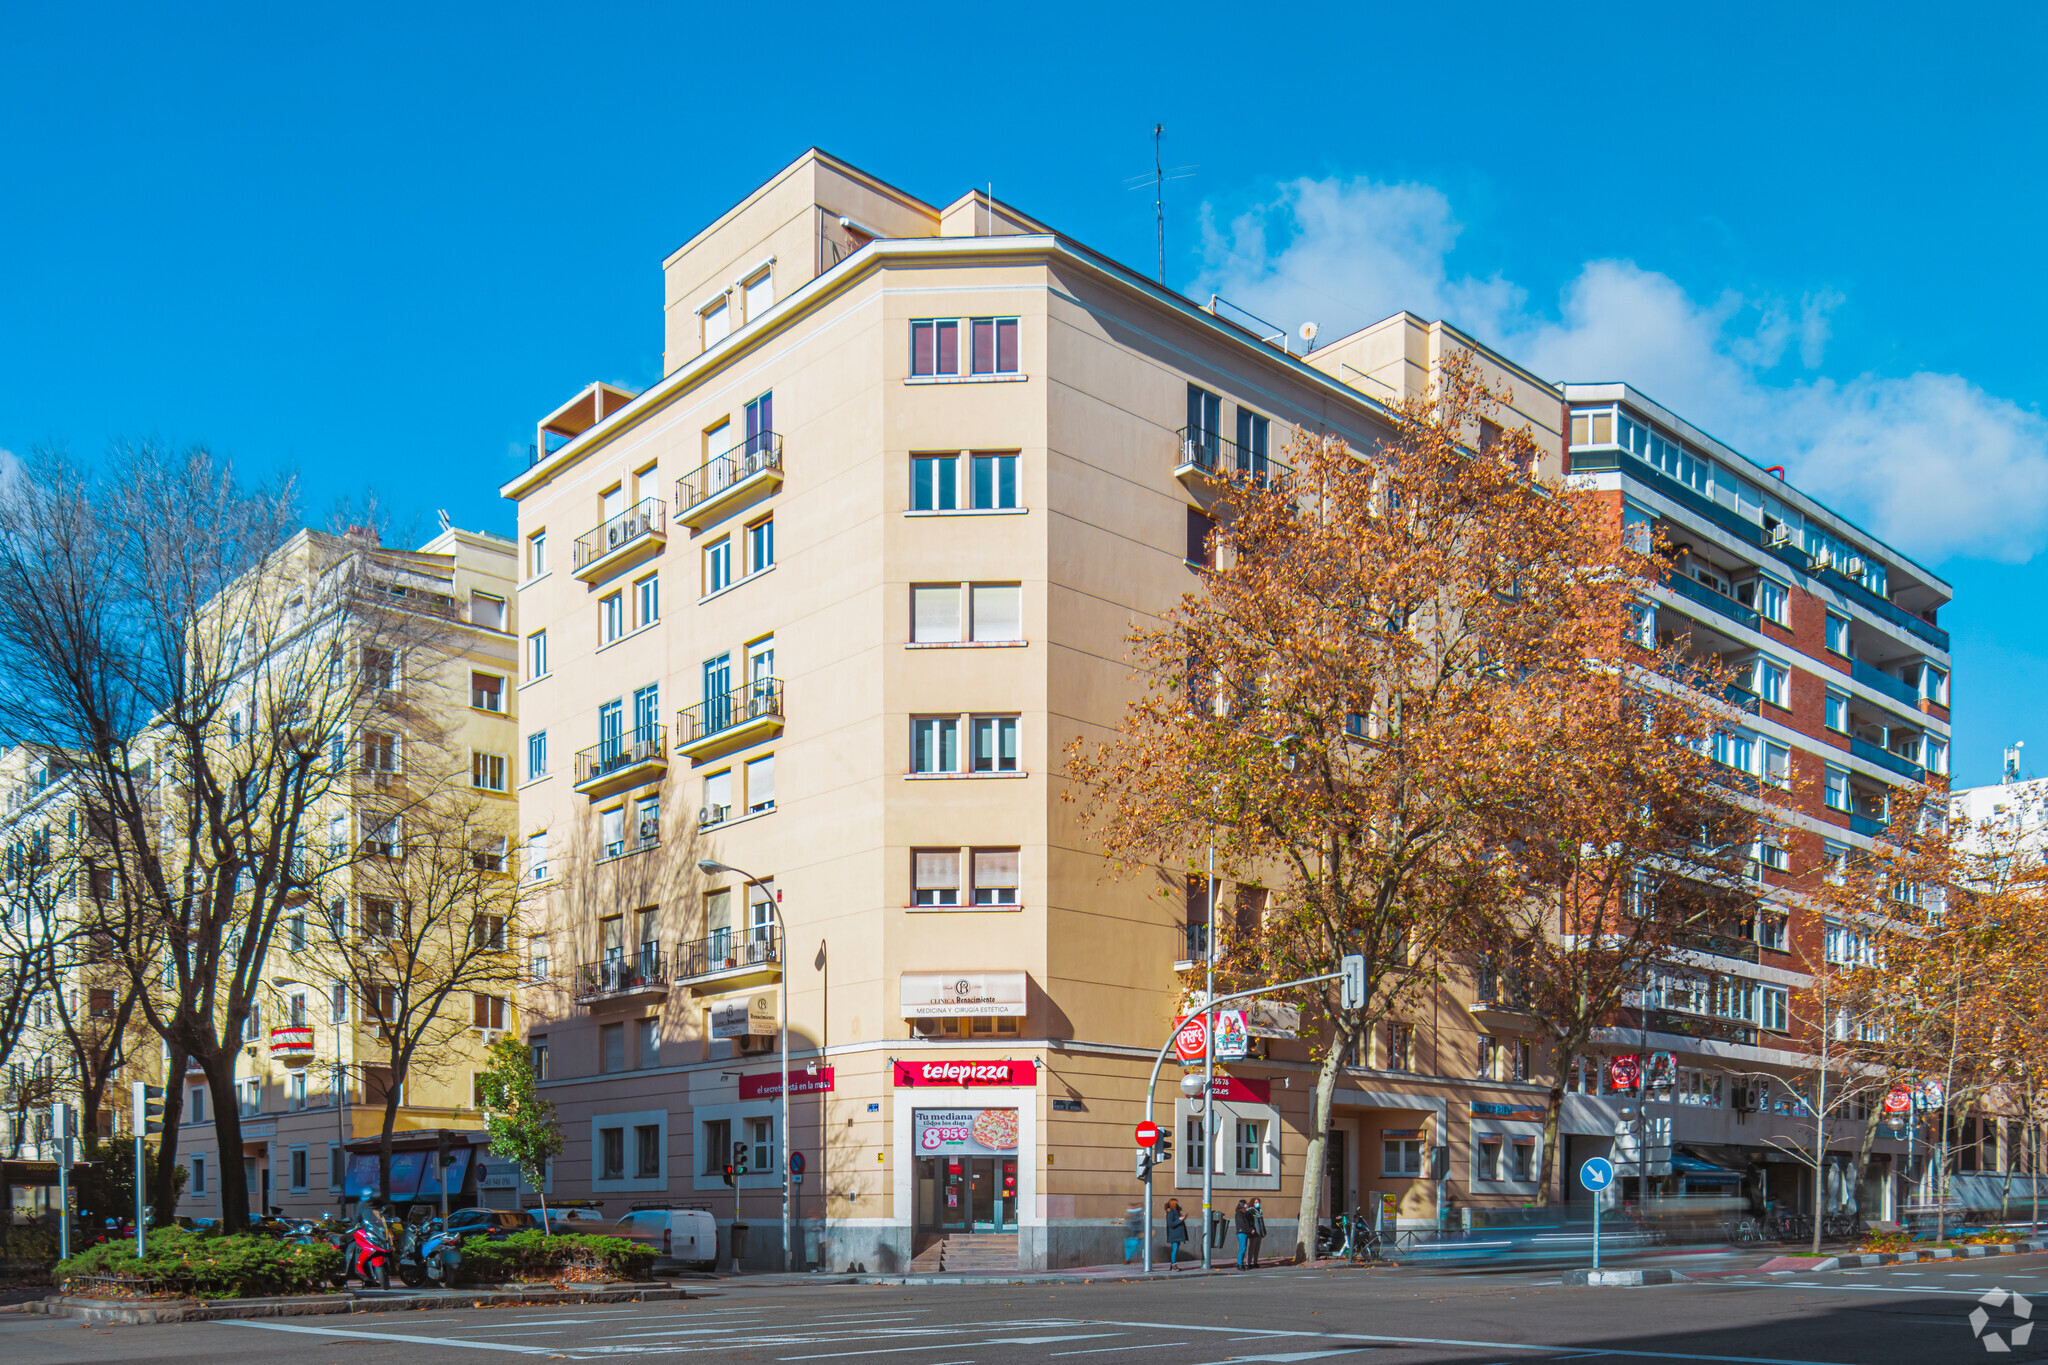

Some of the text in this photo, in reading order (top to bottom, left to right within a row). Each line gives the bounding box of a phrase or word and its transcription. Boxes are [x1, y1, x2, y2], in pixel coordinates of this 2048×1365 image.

[956, 996, 996, 1004] Renacimiento
[921, 1062, 1008, 1084] telepizza
[757, 1085, 763, 1094] el
[807, 1080, 814, 1089] la
[814, 1081, 830, 1089] masa
[930, 1112, 973, 1121] mediana
